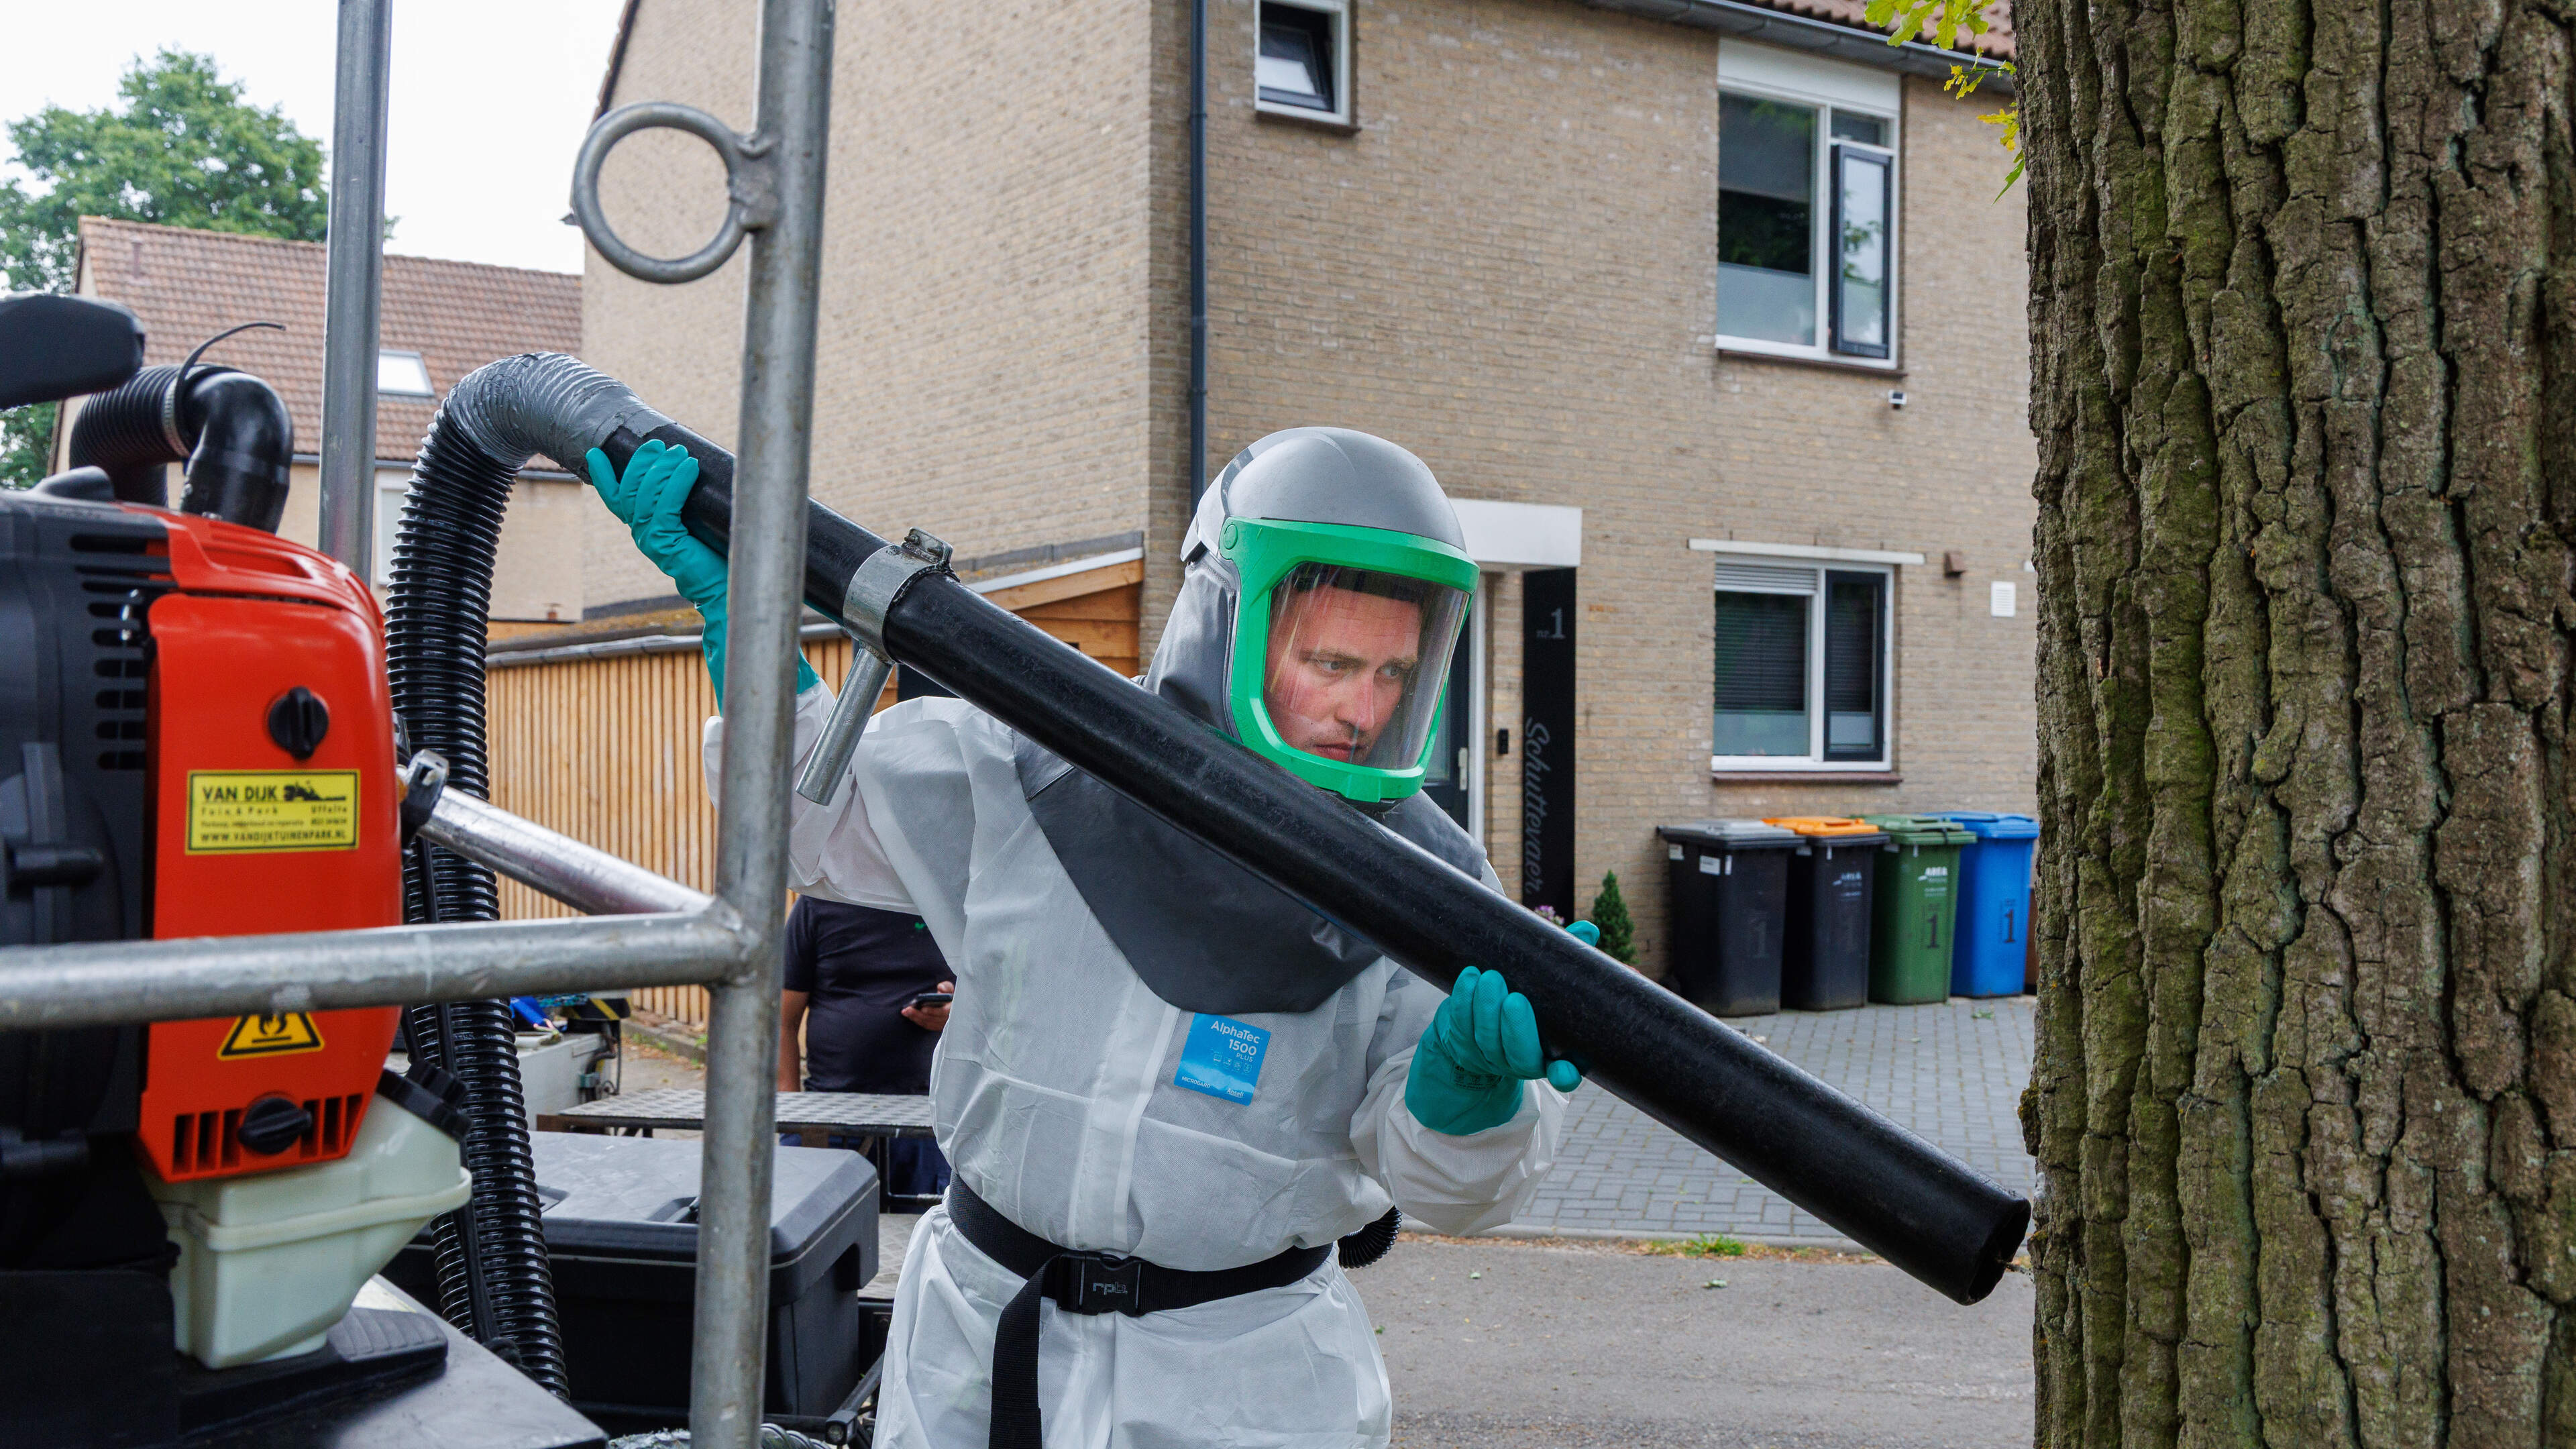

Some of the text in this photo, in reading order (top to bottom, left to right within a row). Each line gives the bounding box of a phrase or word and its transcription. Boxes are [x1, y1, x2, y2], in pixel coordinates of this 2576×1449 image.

[1550, 607, 1566, 639] 1
[202, 785, 278, 801] VAN DIJK
[1927, 913, 1941, 949] 1
[2004, 908, 2016, 943] 1
[1210, 1020, 1260, 1044] AlphaTec
[1228, 1039, 1257, 1057] 1500
[1236, 1052, 1254, 1063] PLUS
[1181, 1075, 1211, 1089] MICROGARD
[1226, 1087, 1244, 1097] Ansell
